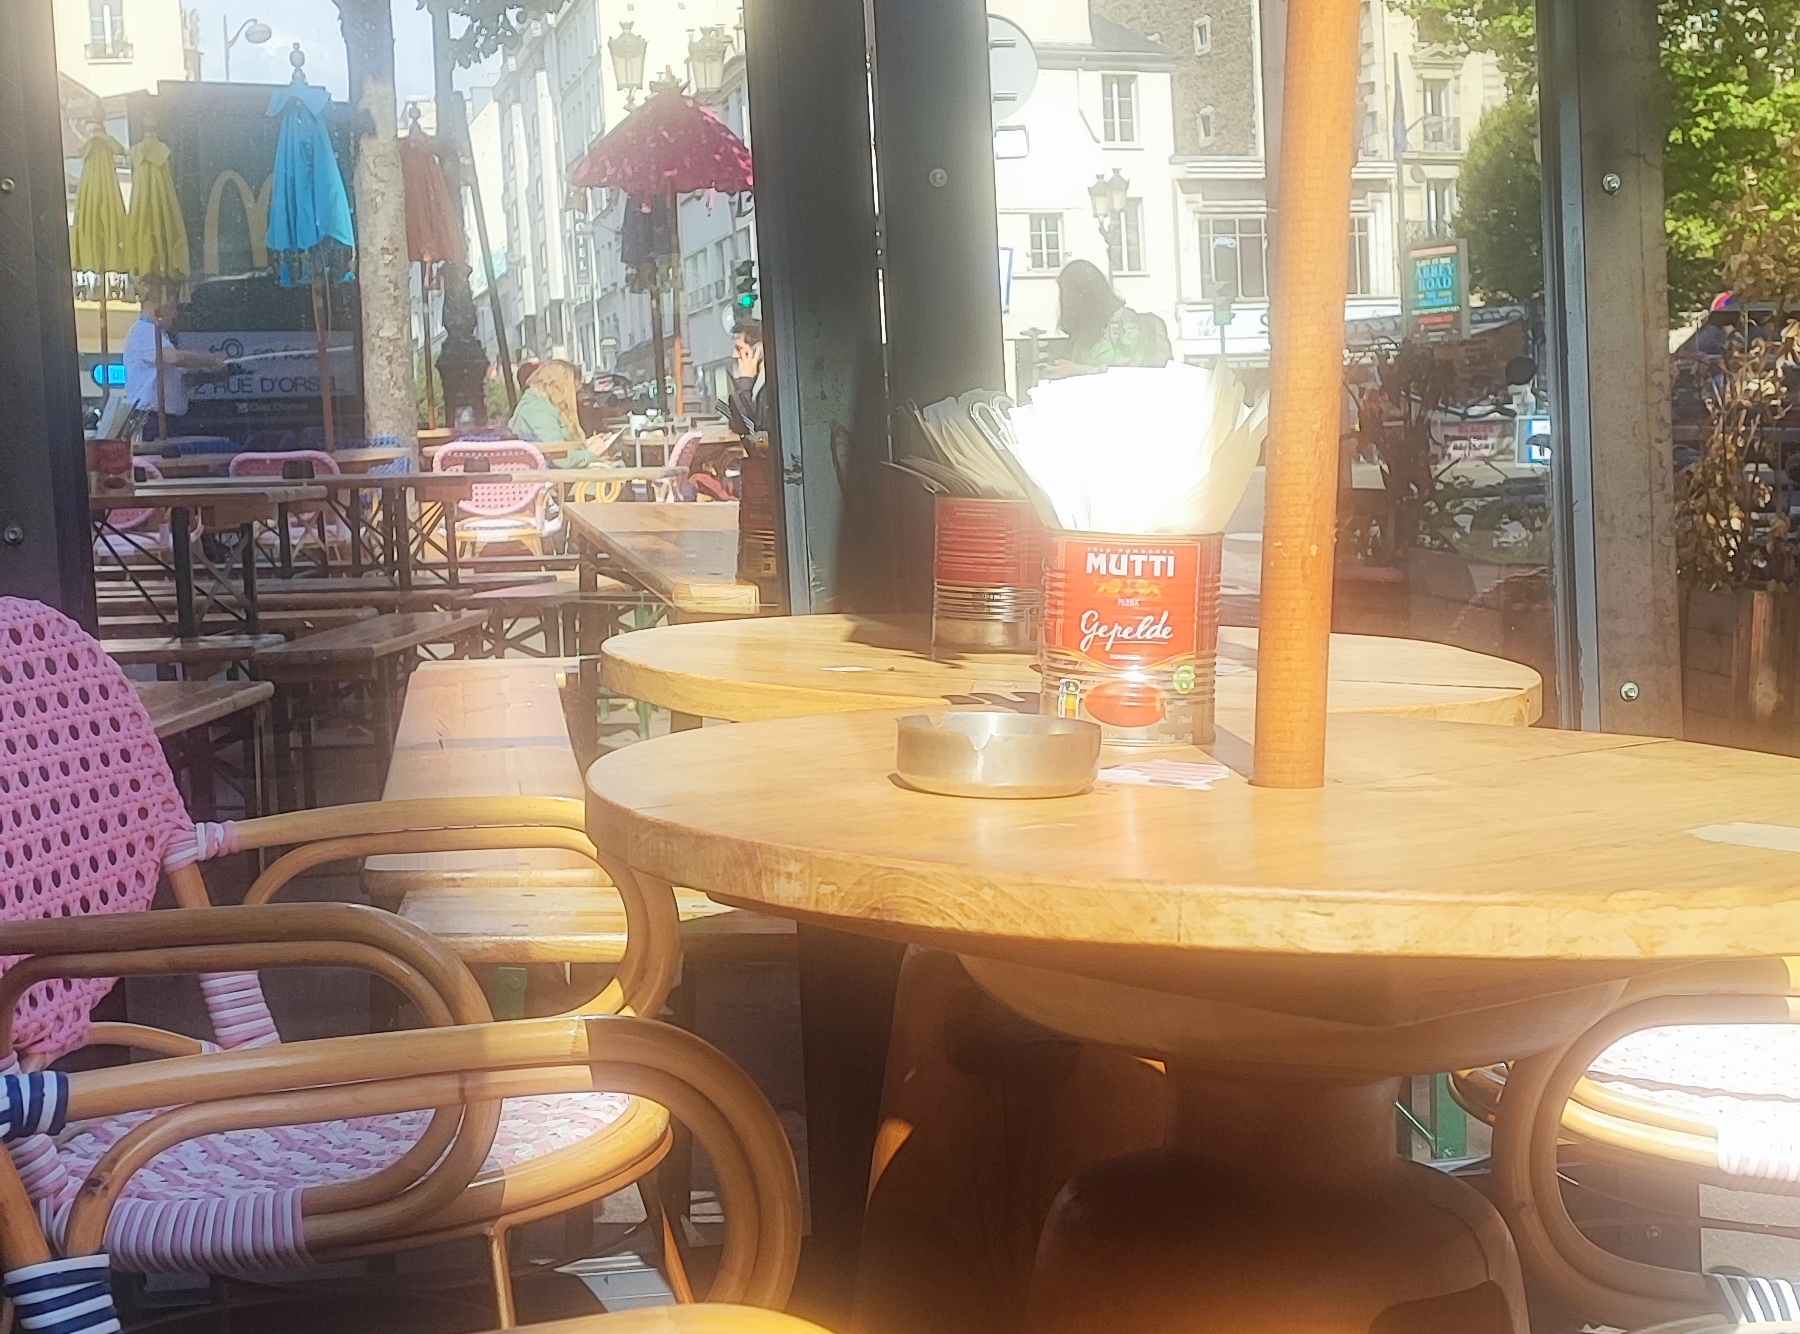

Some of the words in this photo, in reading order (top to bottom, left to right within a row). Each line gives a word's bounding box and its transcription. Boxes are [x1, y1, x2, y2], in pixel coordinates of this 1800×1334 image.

[1418, 276, 1452, 291] ROAD
[260, 376, 344, 394] D'ORSL
[1085, 552, 1175, 578] MUTTI
[1080, 610, 1174, 653] Gepelde
